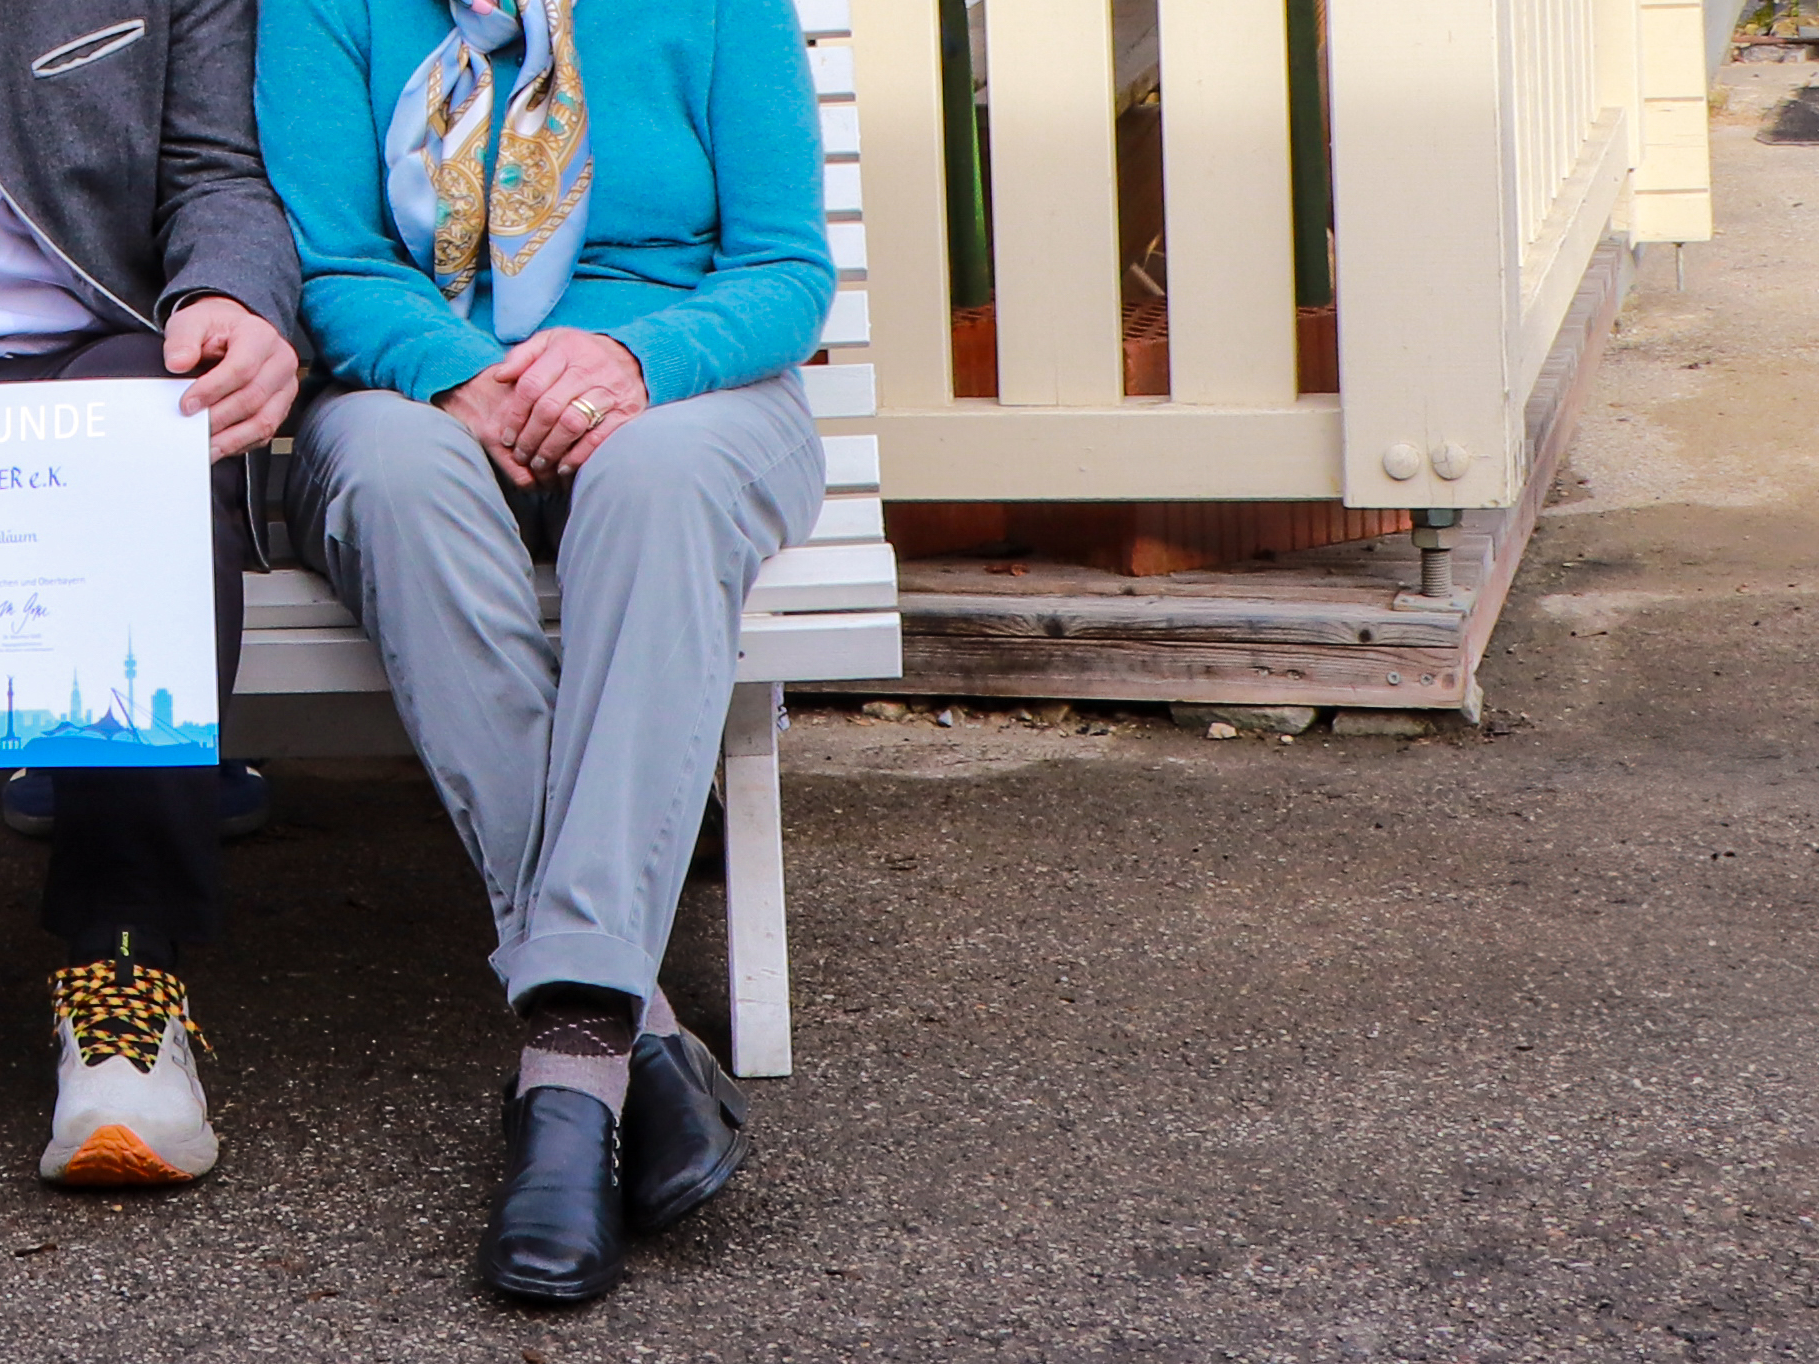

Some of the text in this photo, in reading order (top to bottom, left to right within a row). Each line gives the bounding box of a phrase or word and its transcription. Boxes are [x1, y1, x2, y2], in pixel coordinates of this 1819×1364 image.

[29, 466, 68, 489] e.K.
[21, 578, 37, 587] und
[38, 576, 86, 586] Oberbayern
